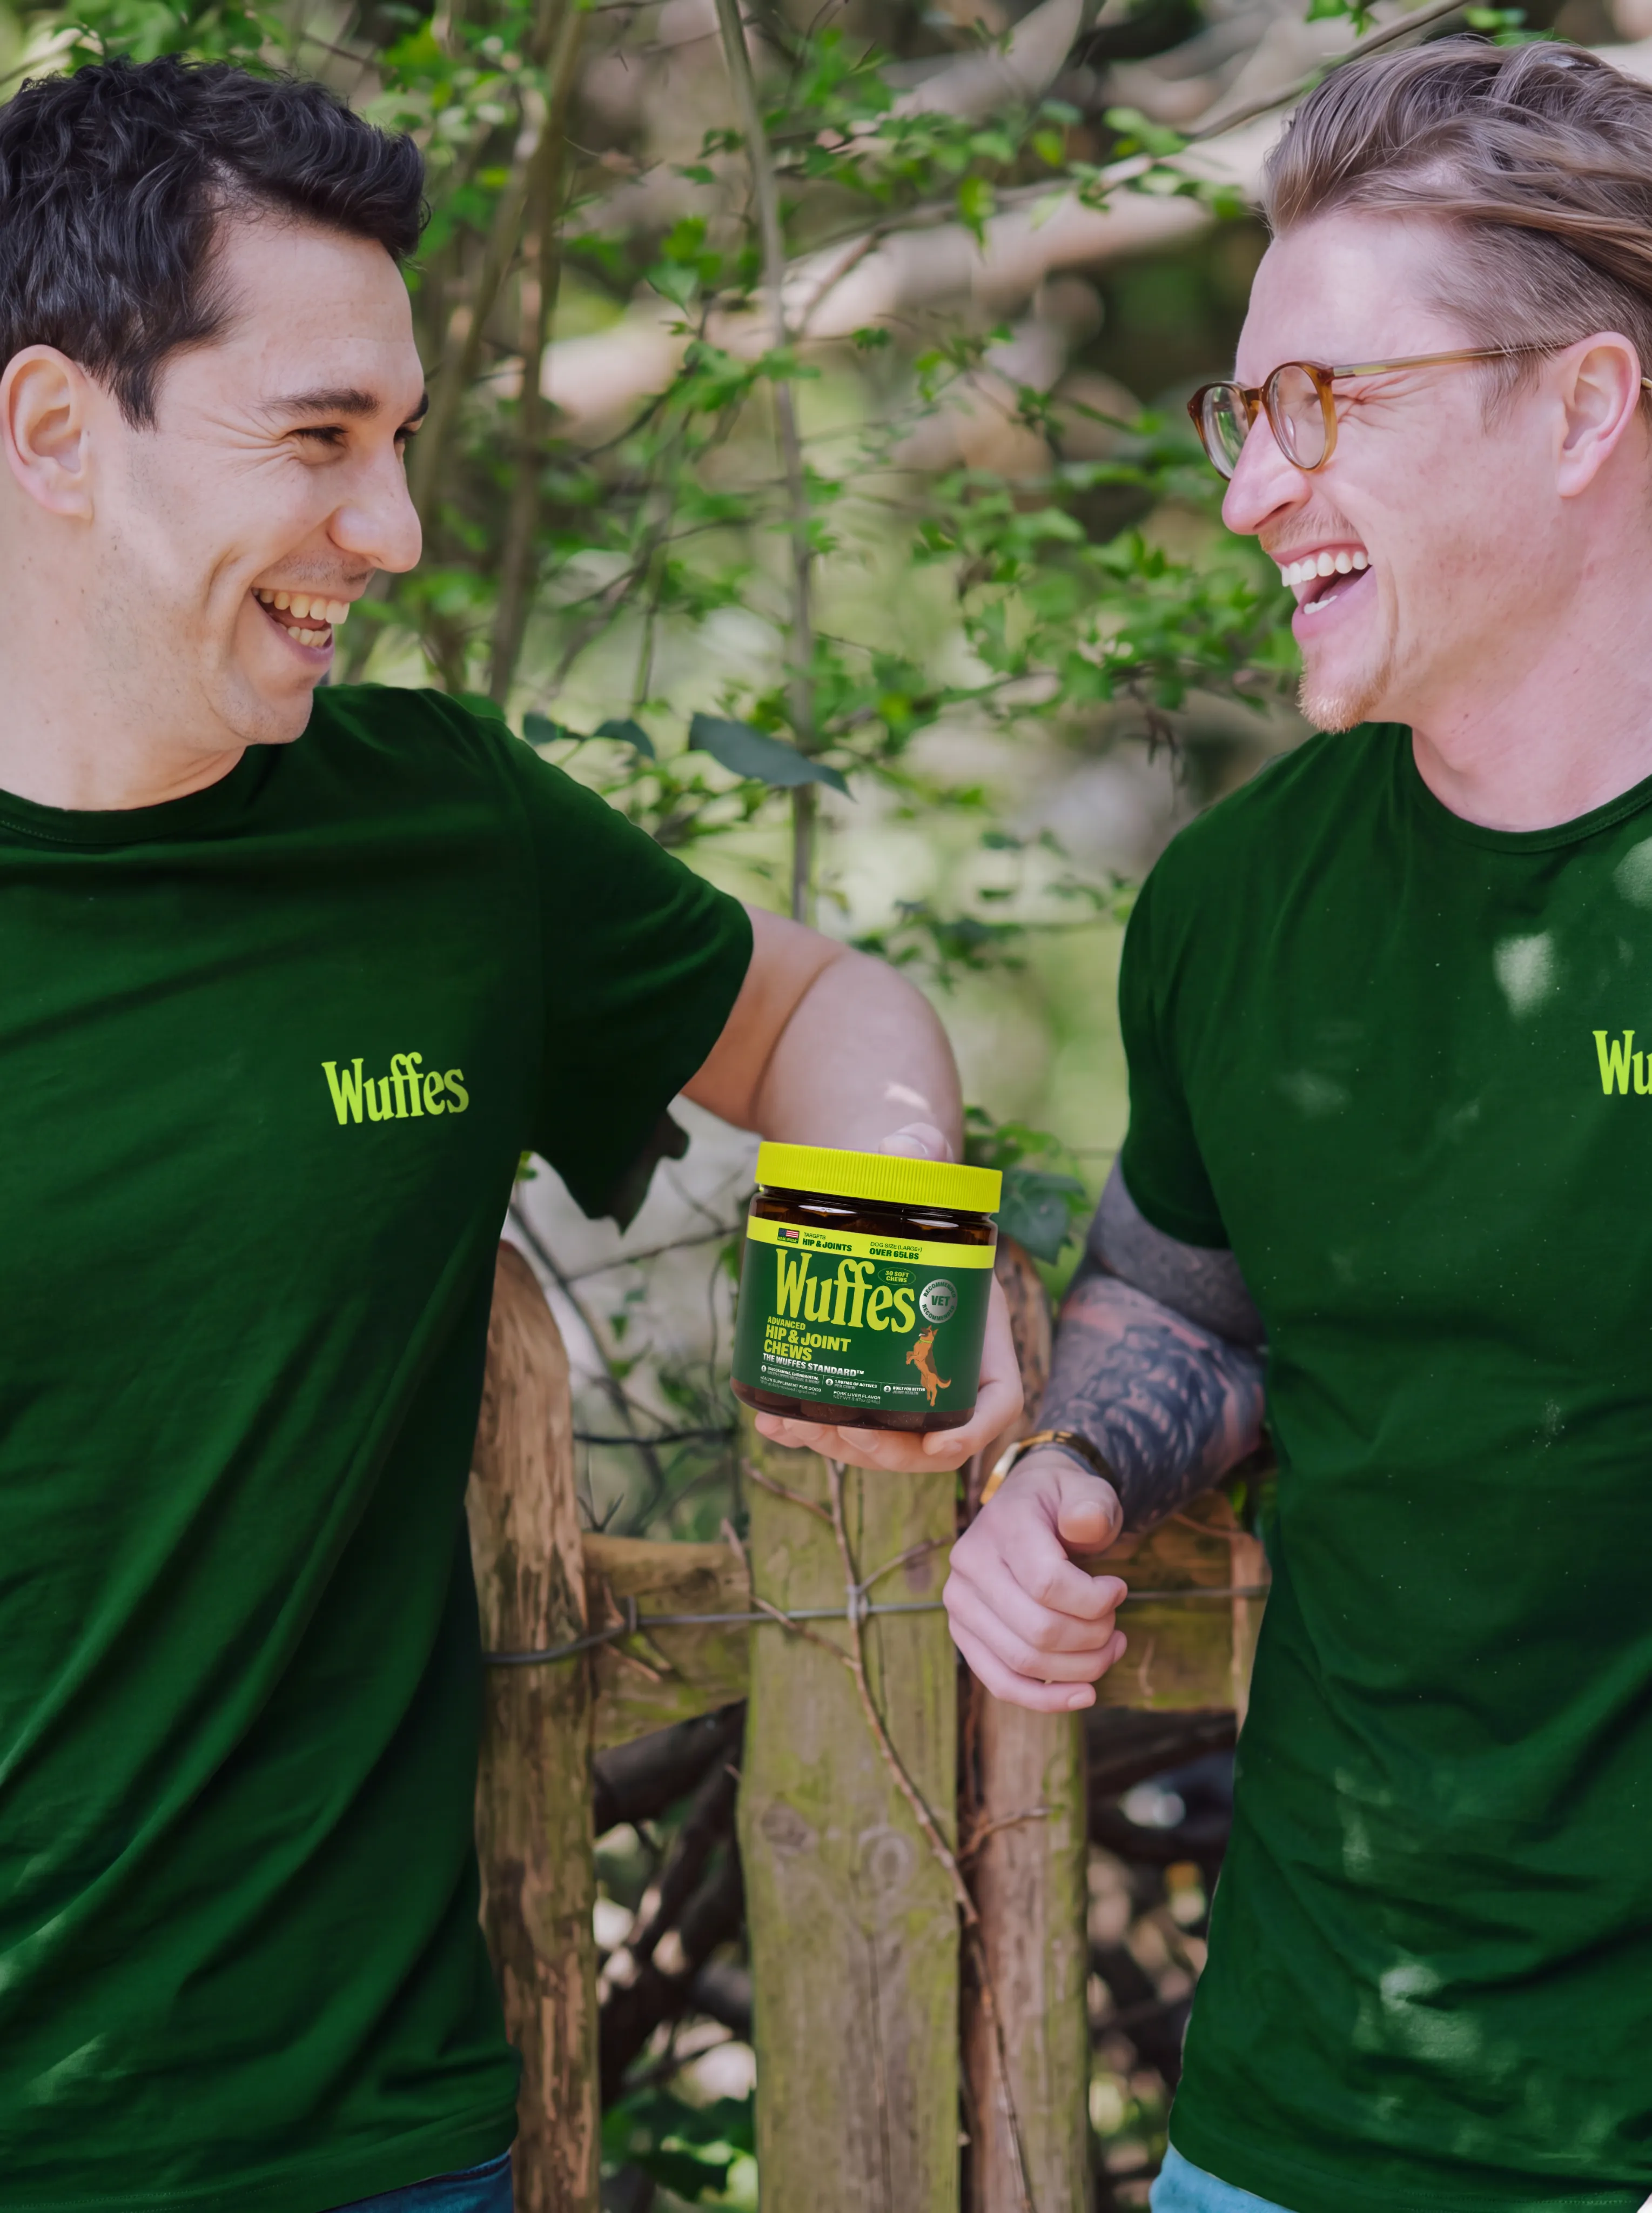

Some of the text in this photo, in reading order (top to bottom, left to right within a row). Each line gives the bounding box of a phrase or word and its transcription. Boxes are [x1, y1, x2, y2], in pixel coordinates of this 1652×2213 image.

[321, 1052, 469, 1125] Wuffes
[822, 1242, 852, 1252] JOINTS
[869, 1248, 919, 1260] OVER 65LBS
[776, 1248, 916, 1333] Wuffes
[923, 1281, 956, 1298] RECOMMENDED
[931, 1295, 950, 1306] VET
[922, 1304, 955, 1321] RECOMMENDED
[767, 1316, 806, 1330] ADVANCED
[765, 1324, 851, 1352] HIP & JOINT
[764, 1339, 812, 1361] CHEWS
[763, 1353, 775, 1362] THE
[776, 1356, 807, 1369] WUFFES
[767, 1366, 791, 1376] GLUCOSAMINE,
[791, 1372, 819, 1381] CHONDROITIN,
[773, 1379, 798, 1388] SUPPLEMENT
